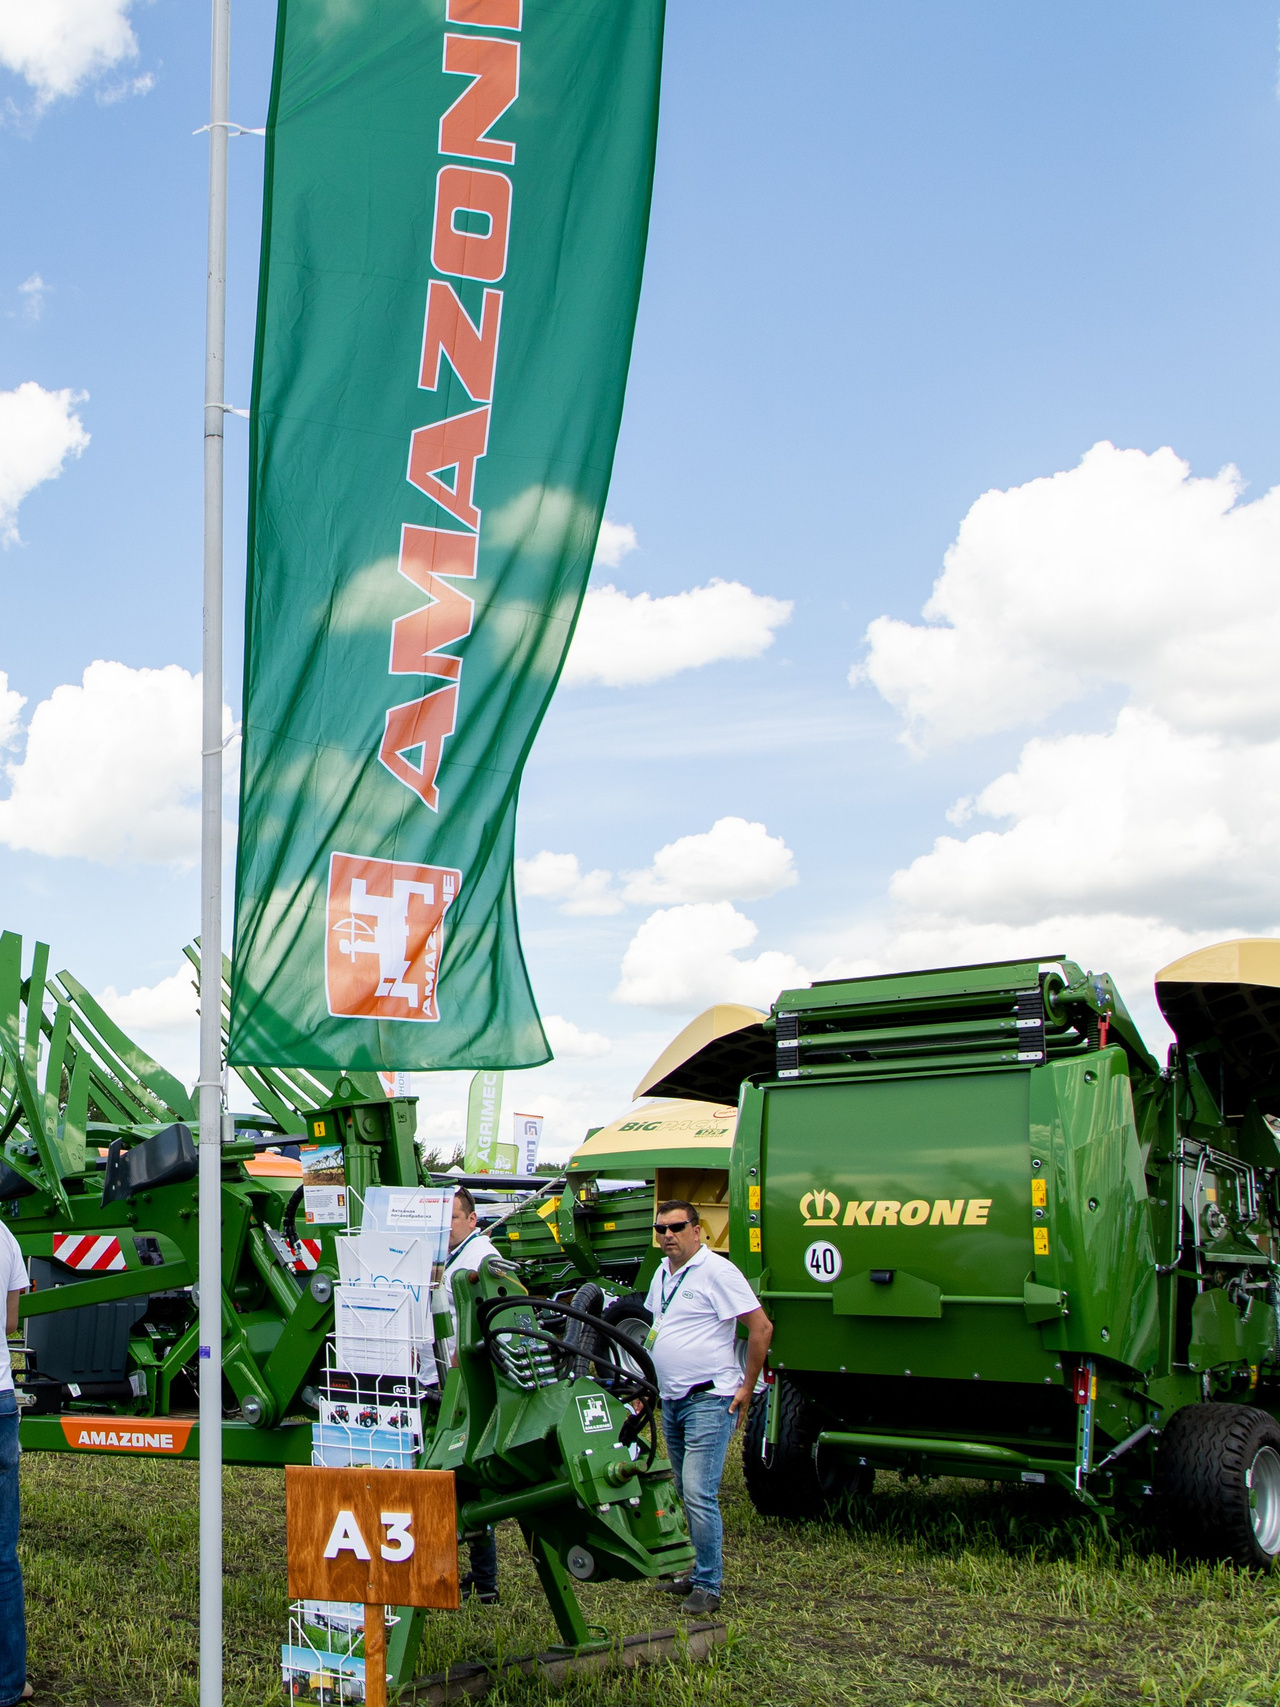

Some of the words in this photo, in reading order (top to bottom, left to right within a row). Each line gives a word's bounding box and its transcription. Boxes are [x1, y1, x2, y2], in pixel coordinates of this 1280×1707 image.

[378, 0, 523, 813] AMAZON
[842, 1199, 992, 1226] KRONE
[810, 1248, 835, 1274] 40
[78, 1430, 174, 1449] AMAZONE
